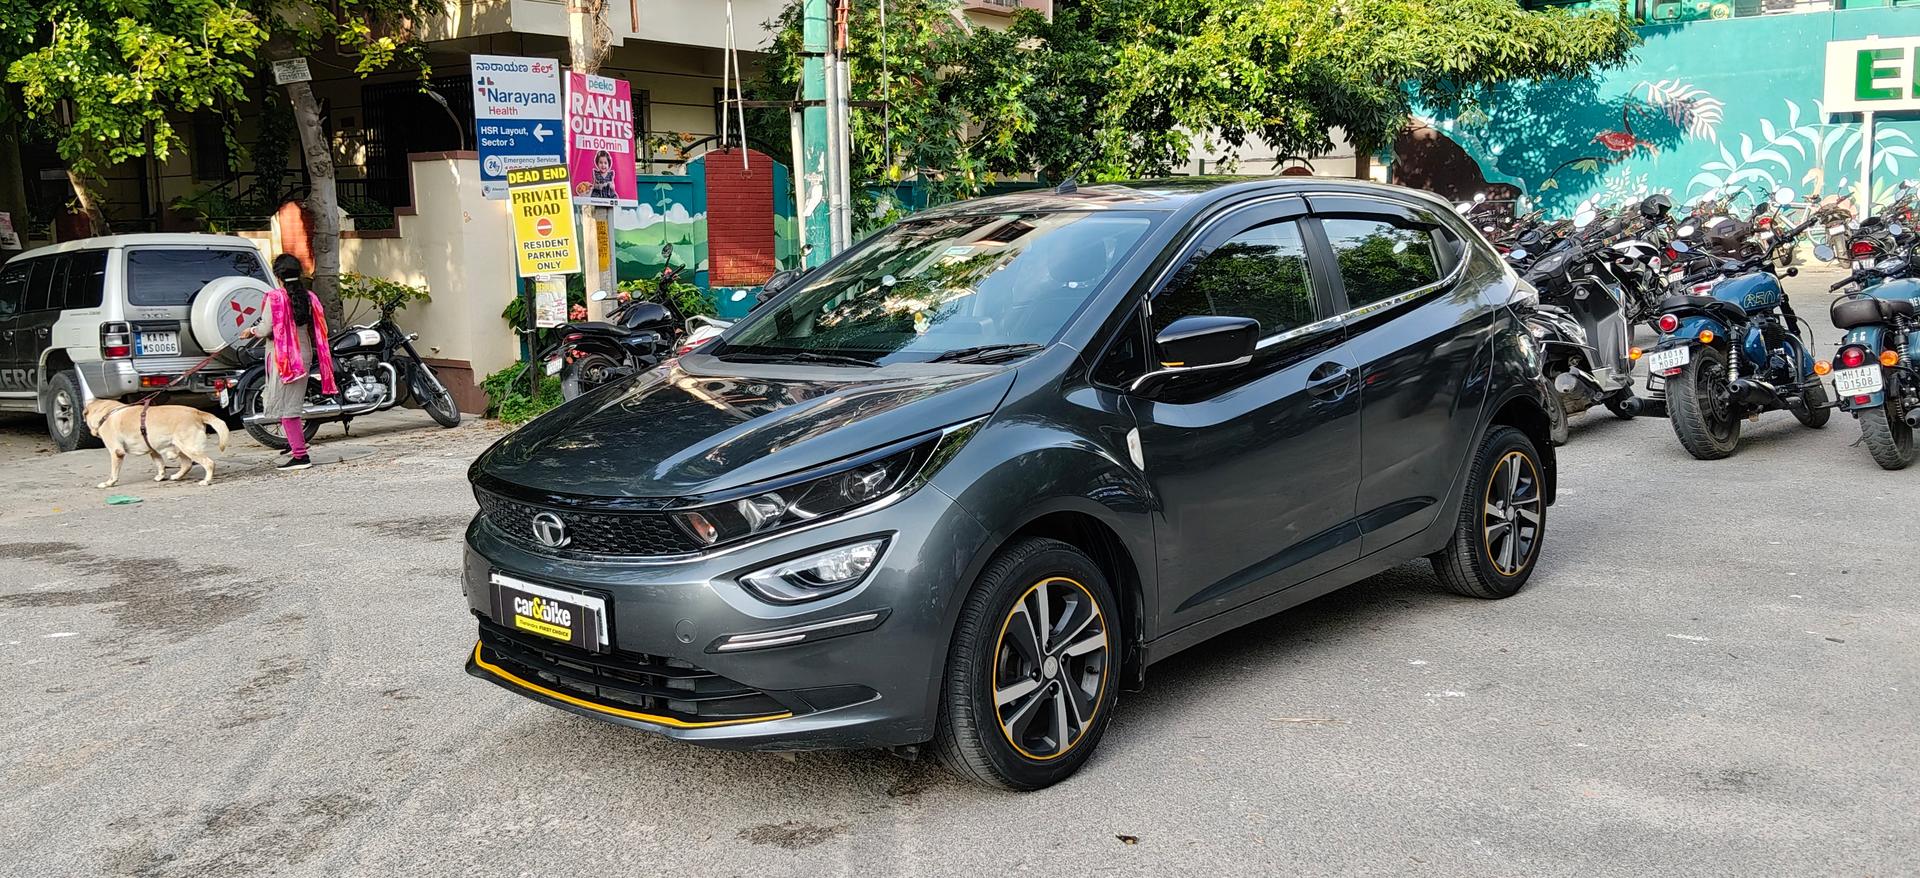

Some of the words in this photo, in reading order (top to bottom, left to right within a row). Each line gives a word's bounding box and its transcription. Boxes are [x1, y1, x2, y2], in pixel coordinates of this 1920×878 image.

[1855, 47, 1920, 101] E
[588, 79, 614, 92] peeko
[487, 87, 556, 106] Narayana
[488, 106, 518, 115] Health
[572, 92, 631, 121] RAKHI
[480, 126, 498, 134] HSR
[500, 127, 529, 136] Layout,
[571, 115, 633, 139] OUTFITS
[481, 138, 507, 146] Sector
[509, 138, 515, 146] 3
[582, 136, 591, 148] in
[593, 138, 622, 151] 60min
[503, 156, 535, 164] Emergency
[508, 170, 540, 184] DEAD
[542, 167, 567, 180] END
[512, 187, 569, 204] PRIVATE
[523, 203, 560, 217] ROAD
[523, 239, 569, 250] RESIDENT
[527, 249, 569, 260] PARKING
[537, 261, 561, 270] ONLY
[1841, 367, 1872, 380] MH14J
[1843, 377, 1874, 389] D1508
[514, 596, 572, 627] car&bike
[538, 625, 552, 633] FIRST
[552, 628, 569, 637] CHOICE
